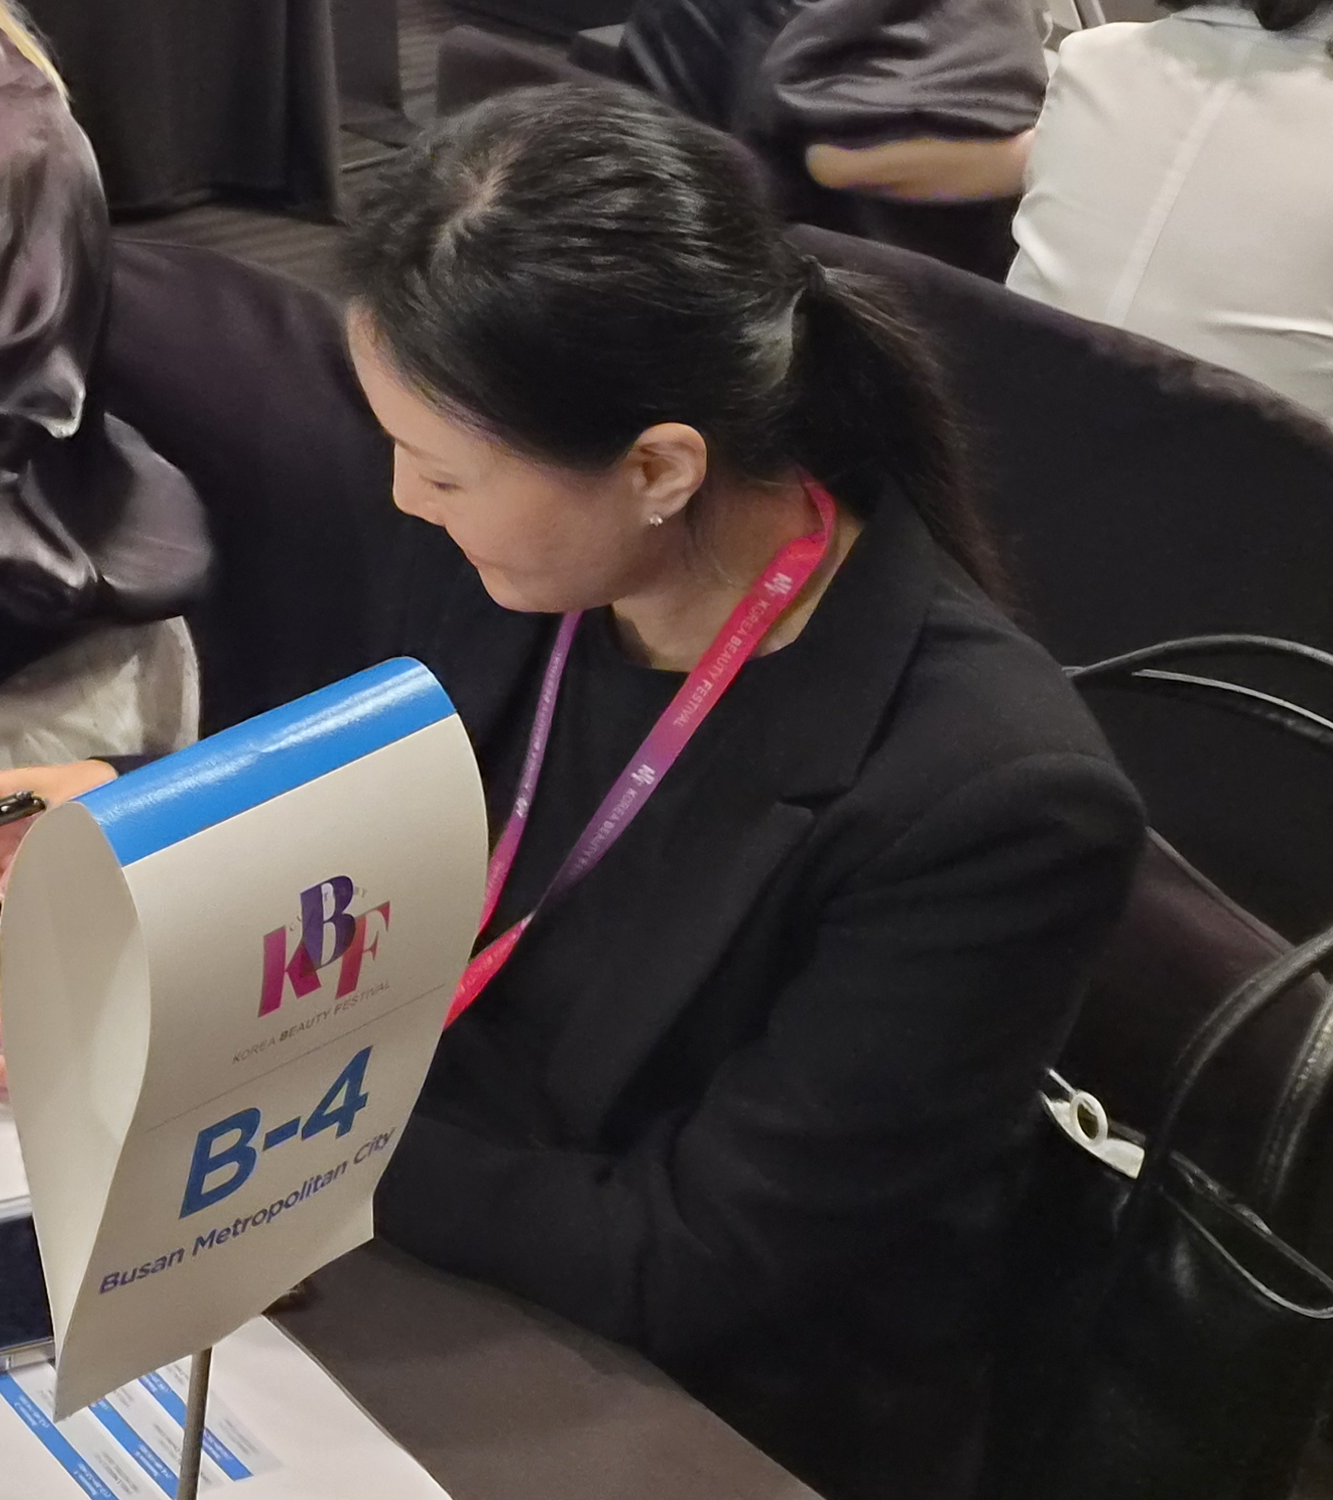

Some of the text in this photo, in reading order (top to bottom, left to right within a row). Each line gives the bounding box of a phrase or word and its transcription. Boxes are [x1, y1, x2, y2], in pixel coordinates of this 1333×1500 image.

[672, 599, 770, 730] KOREA BEAUTY FESTIVAL
[258, 875, 390, 1018] KBF
[232, 979, 392, 1065] KOREA BEAUTY FESTIVAL
[178, 1045, 374, 1221] B-4
[98, 1126, 398, 1295] Busan Metropolitan City
